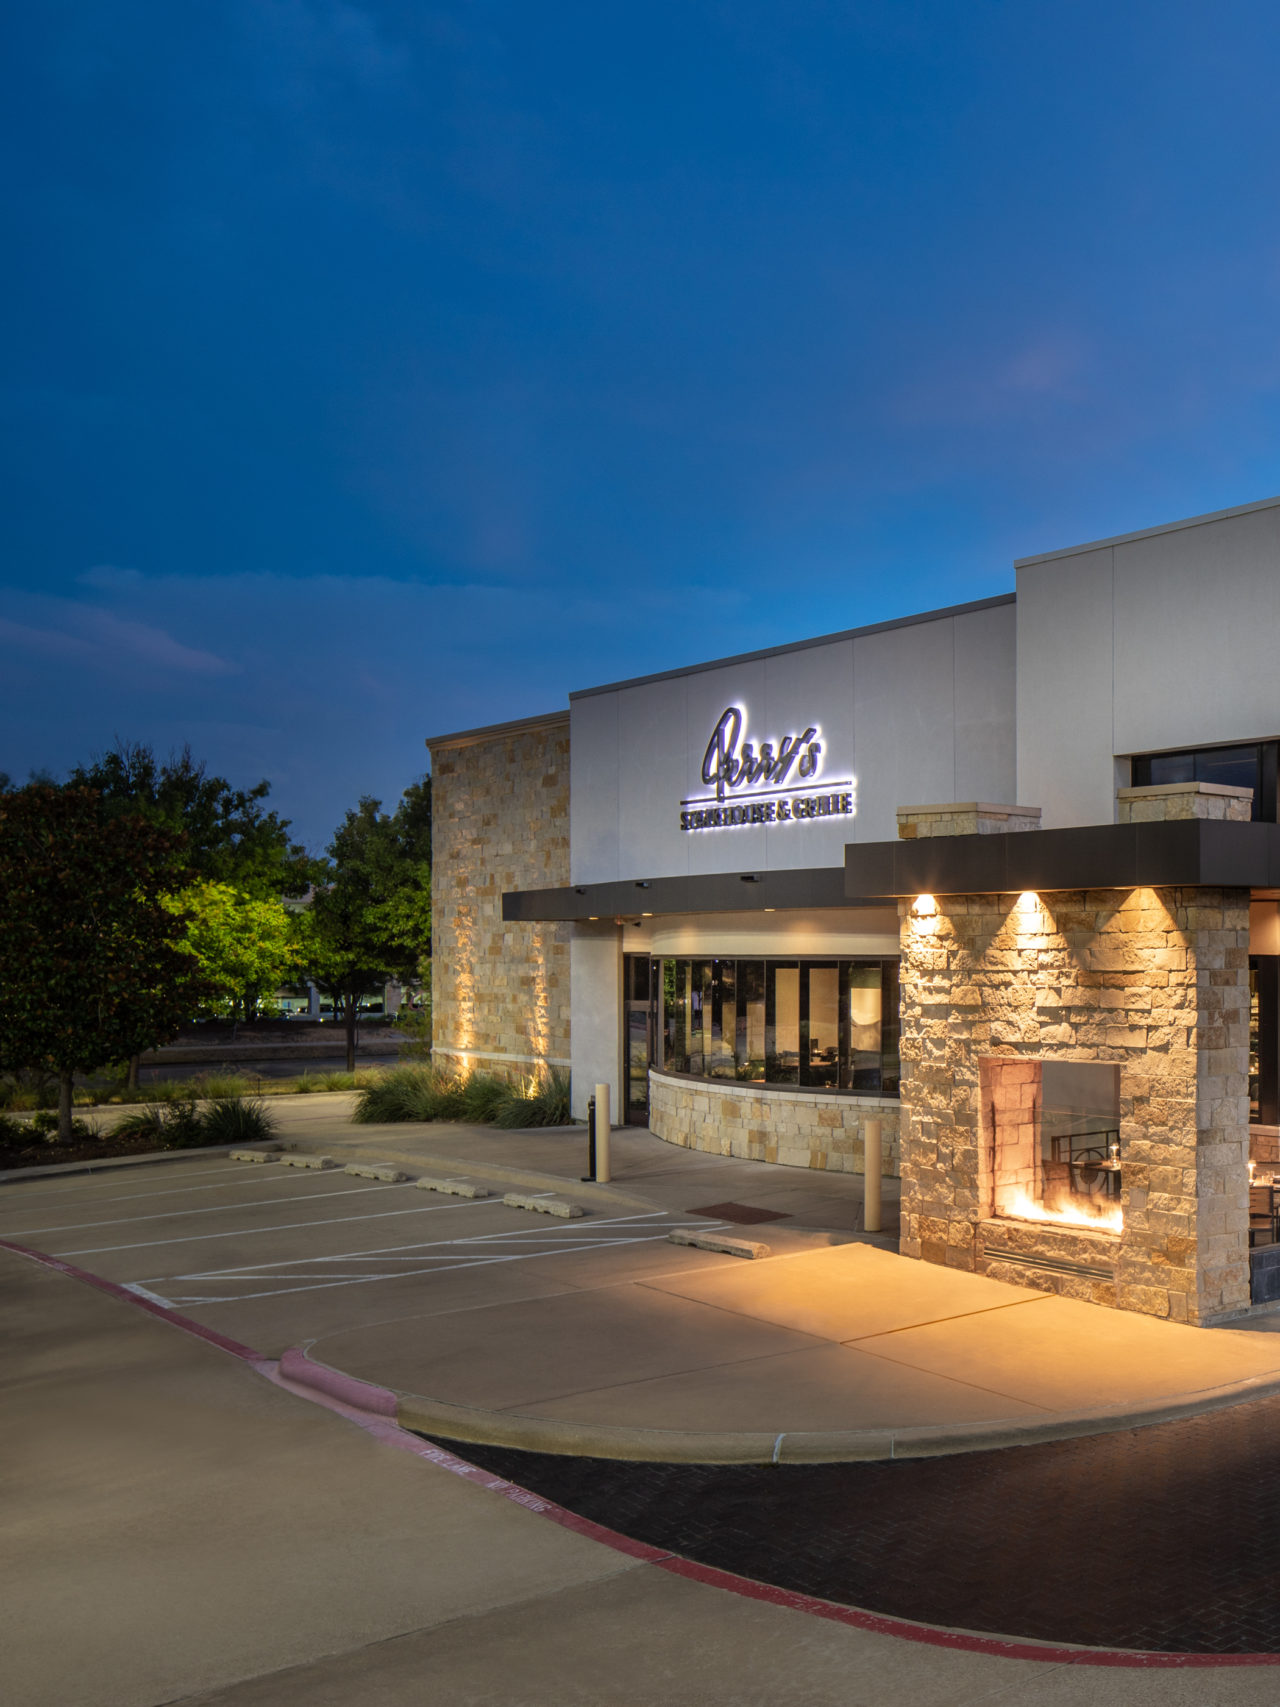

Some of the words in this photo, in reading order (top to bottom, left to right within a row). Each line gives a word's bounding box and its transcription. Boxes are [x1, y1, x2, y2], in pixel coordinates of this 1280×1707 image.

[702, 707, 821, 803] Perry's
[680, 803, 776, 830] STEAKHOUSE
[776, 800, 793, 820] &
[792, 793, 852, 819] GRILLE
